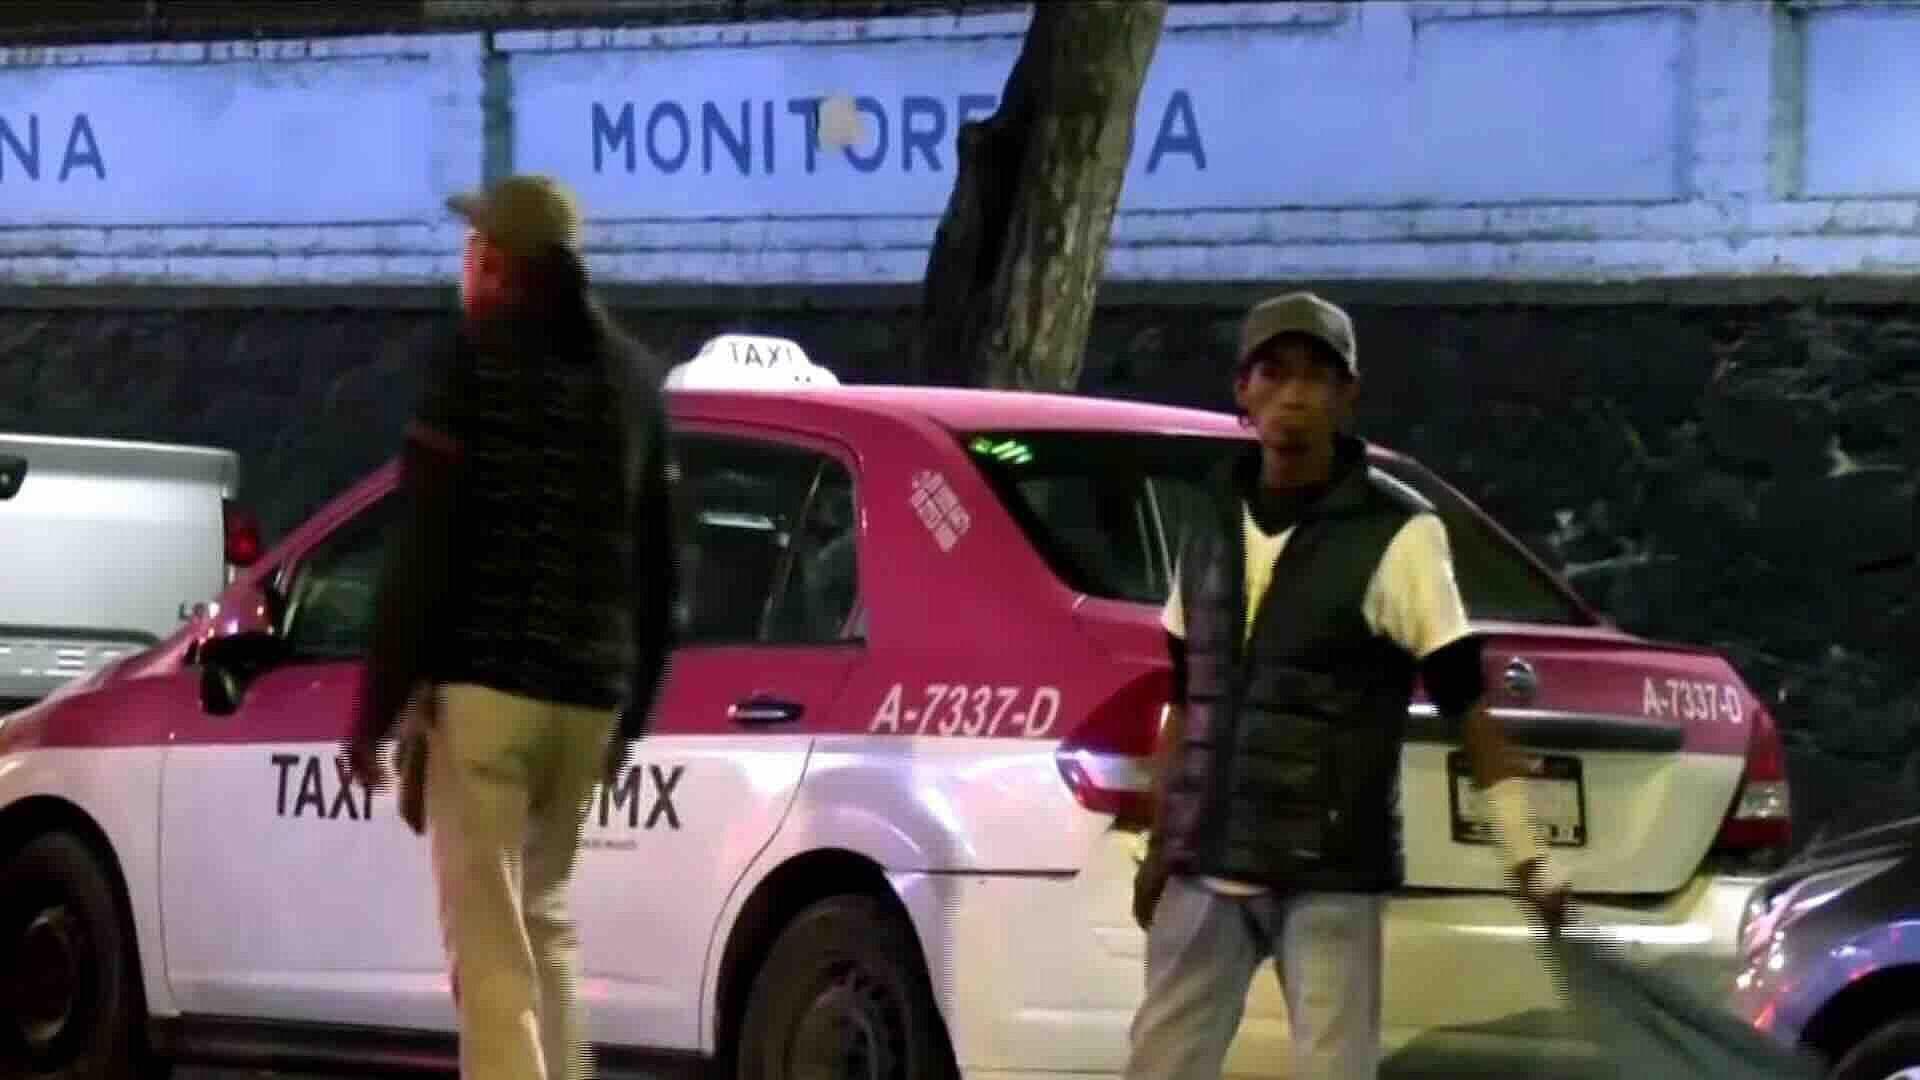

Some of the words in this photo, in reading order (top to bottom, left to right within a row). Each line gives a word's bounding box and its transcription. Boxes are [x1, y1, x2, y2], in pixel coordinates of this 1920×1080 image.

[591, 90, 1207, 175] MONITORA
[727, 342, 794, 368] TAXI
[869, 682, 1061, 737] A-7337-D
[1643, 677, 1743, 723] A-7337-D
[272, 754, 372, 821] TAXI
[582, 764, 685, 829] MX
